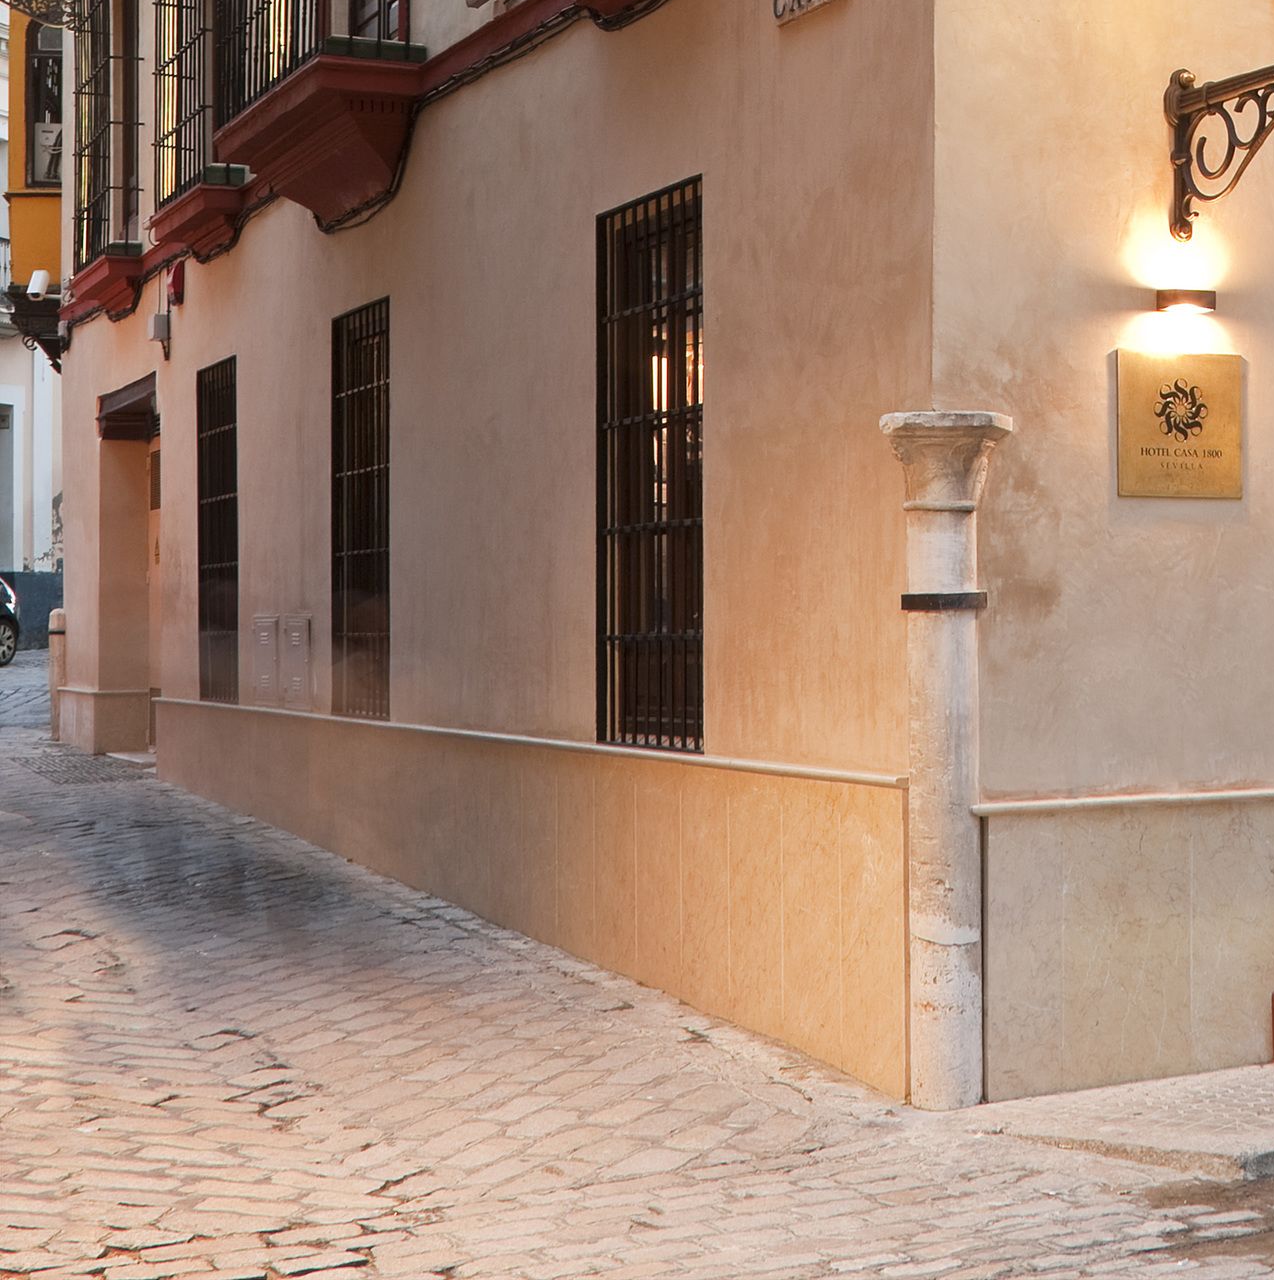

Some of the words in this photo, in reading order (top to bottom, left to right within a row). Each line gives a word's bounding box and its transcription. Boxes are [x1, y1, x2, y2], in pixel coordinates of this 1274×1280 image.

[1140, 447, 1169, 457] HOTEL
[1174, 448, 1199, 458] CASA
[1202, 449, 1223, 459] 1800
[1160, 462, 1204, 470] SEVILLA
